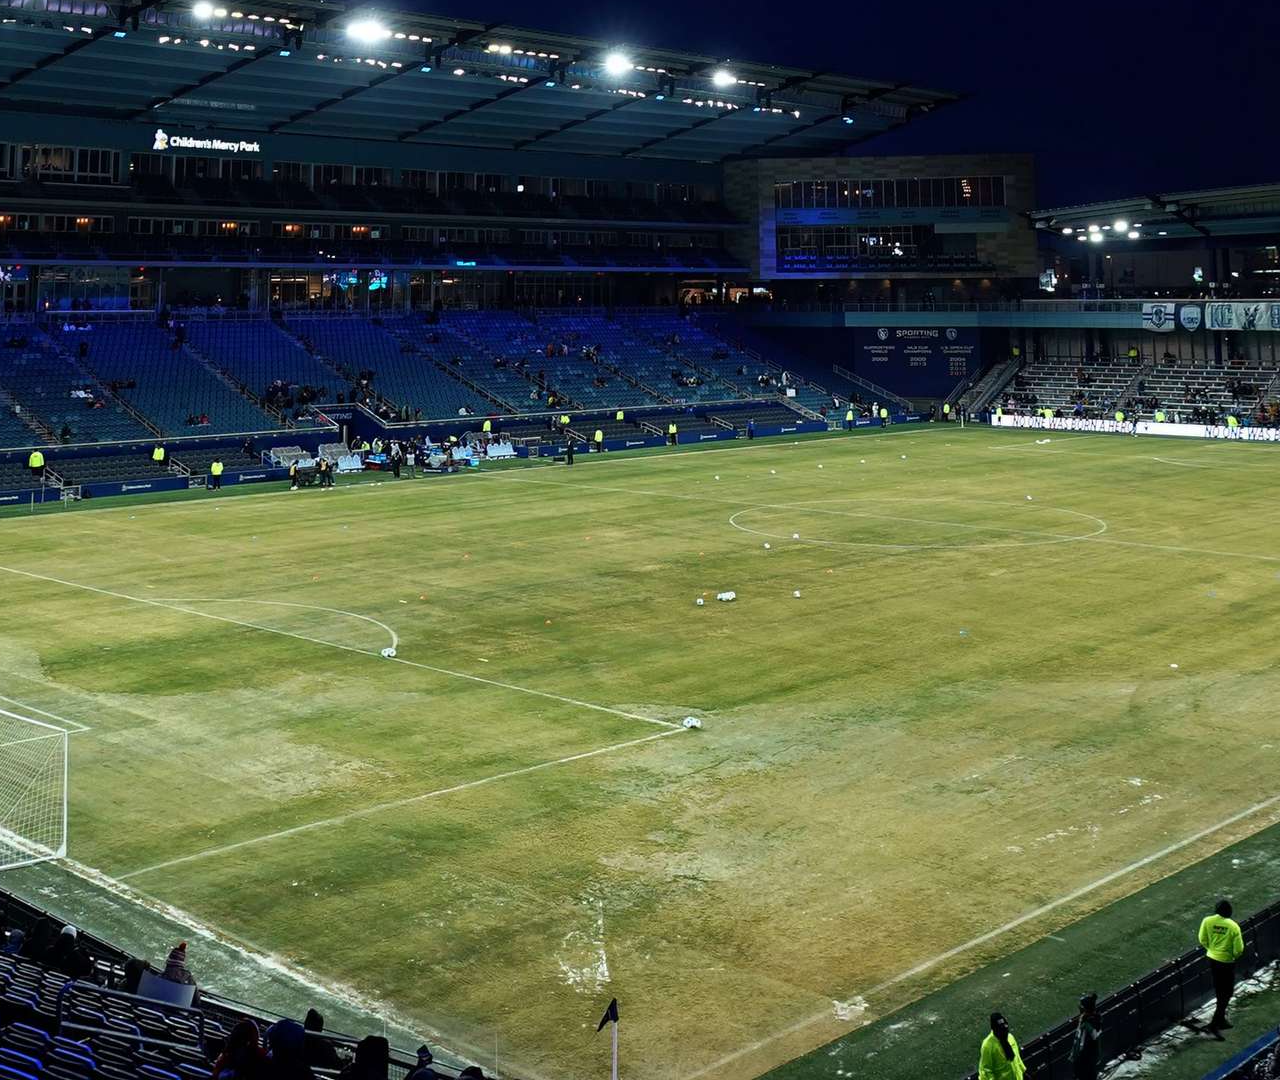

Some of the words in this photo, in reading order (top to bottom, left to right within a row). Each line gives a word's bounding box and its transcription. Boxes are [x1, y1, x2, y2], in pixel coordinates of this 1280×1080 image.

[170, 136, 212, 149] Children's
[212, 139, 240, 153] Mercy
[240, 141, 260, 153] Park
[1210, 304, 1233, 328] KC
[896, 329, 939, 338] SPORTING
[1013, 415, 1025, 427] NO
[1027, 416, 1048, 428] ONE
[1049, 417, 1072, 430] WAS
[1072, 418, 1098, 432] BORN
[1204, 425, 1219, 438] NO
[1222, 426, 1244, 439] ONE
[1247, 427, 1270, 440] WAS
